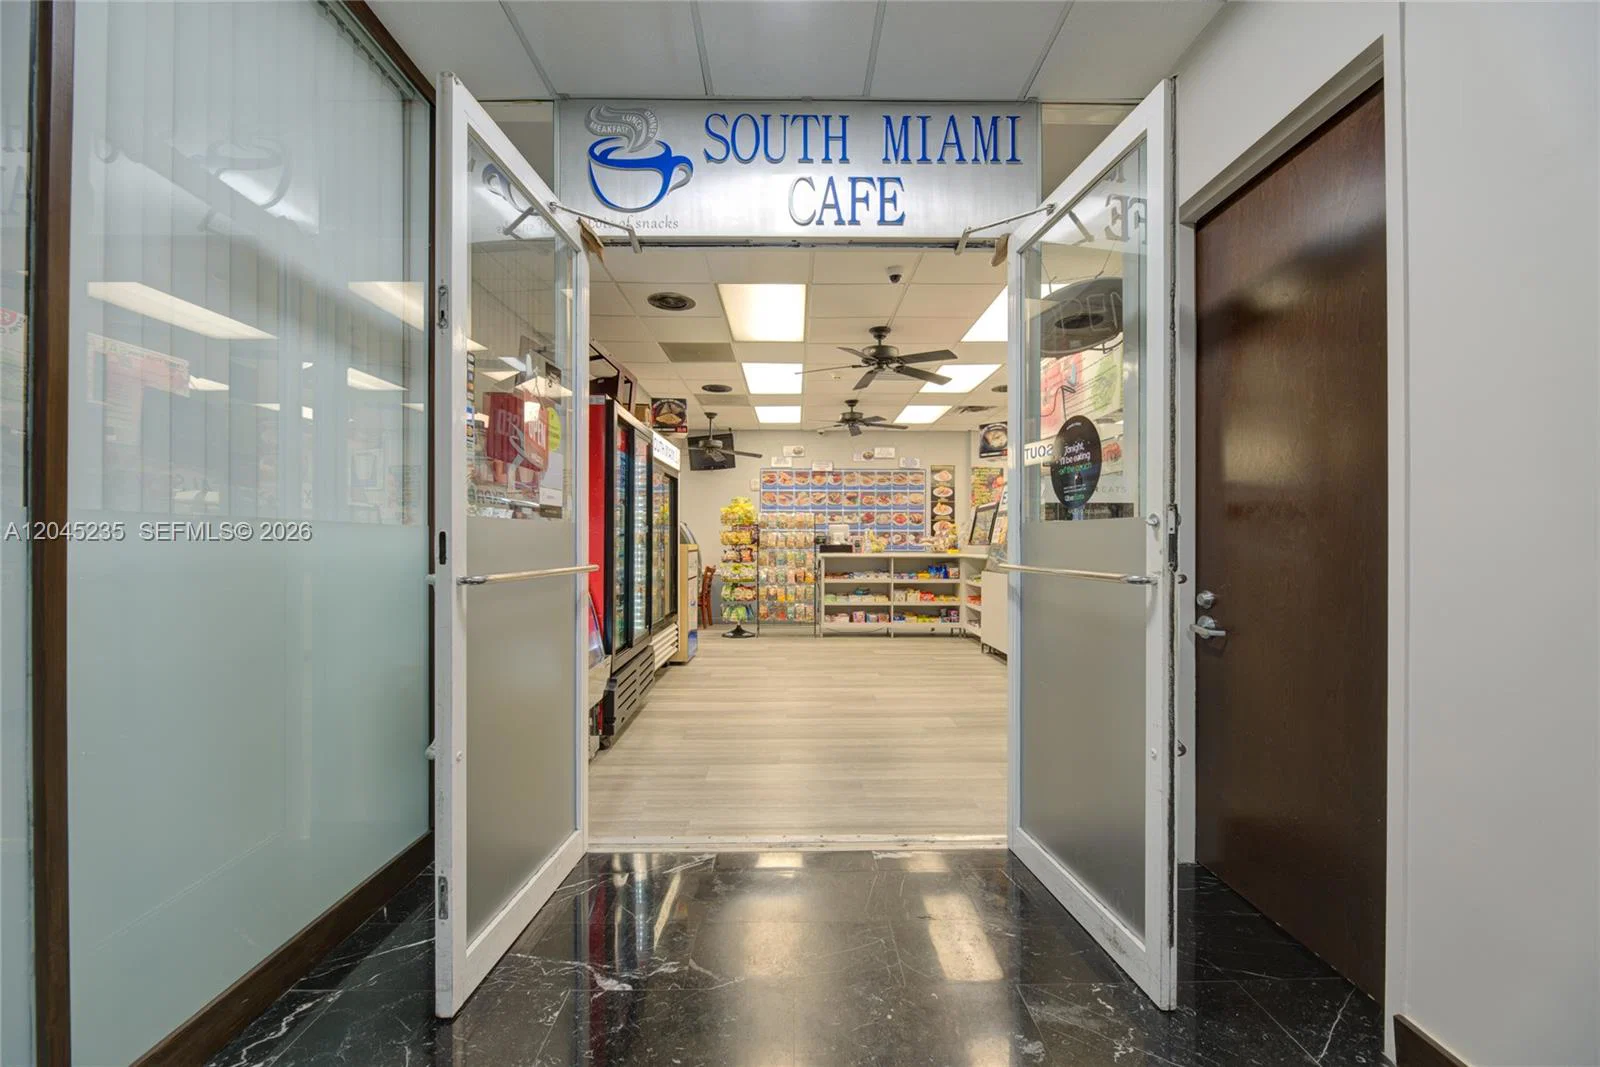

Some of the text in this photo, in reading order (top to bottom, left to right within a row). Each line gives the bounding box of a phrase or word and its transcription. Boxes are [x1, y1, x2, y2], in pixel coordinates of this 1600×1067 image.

[589, 121, 628, 134] BREAKFAST
[622, 114, 643, 130] LUNCH
[644, 111, 657, 138] DINNER
[703, 113, 1023, 164] SOUTH MIAMI
[788, 176, 906, 227] CAFE
[635, 214, 679, 229] snacks
